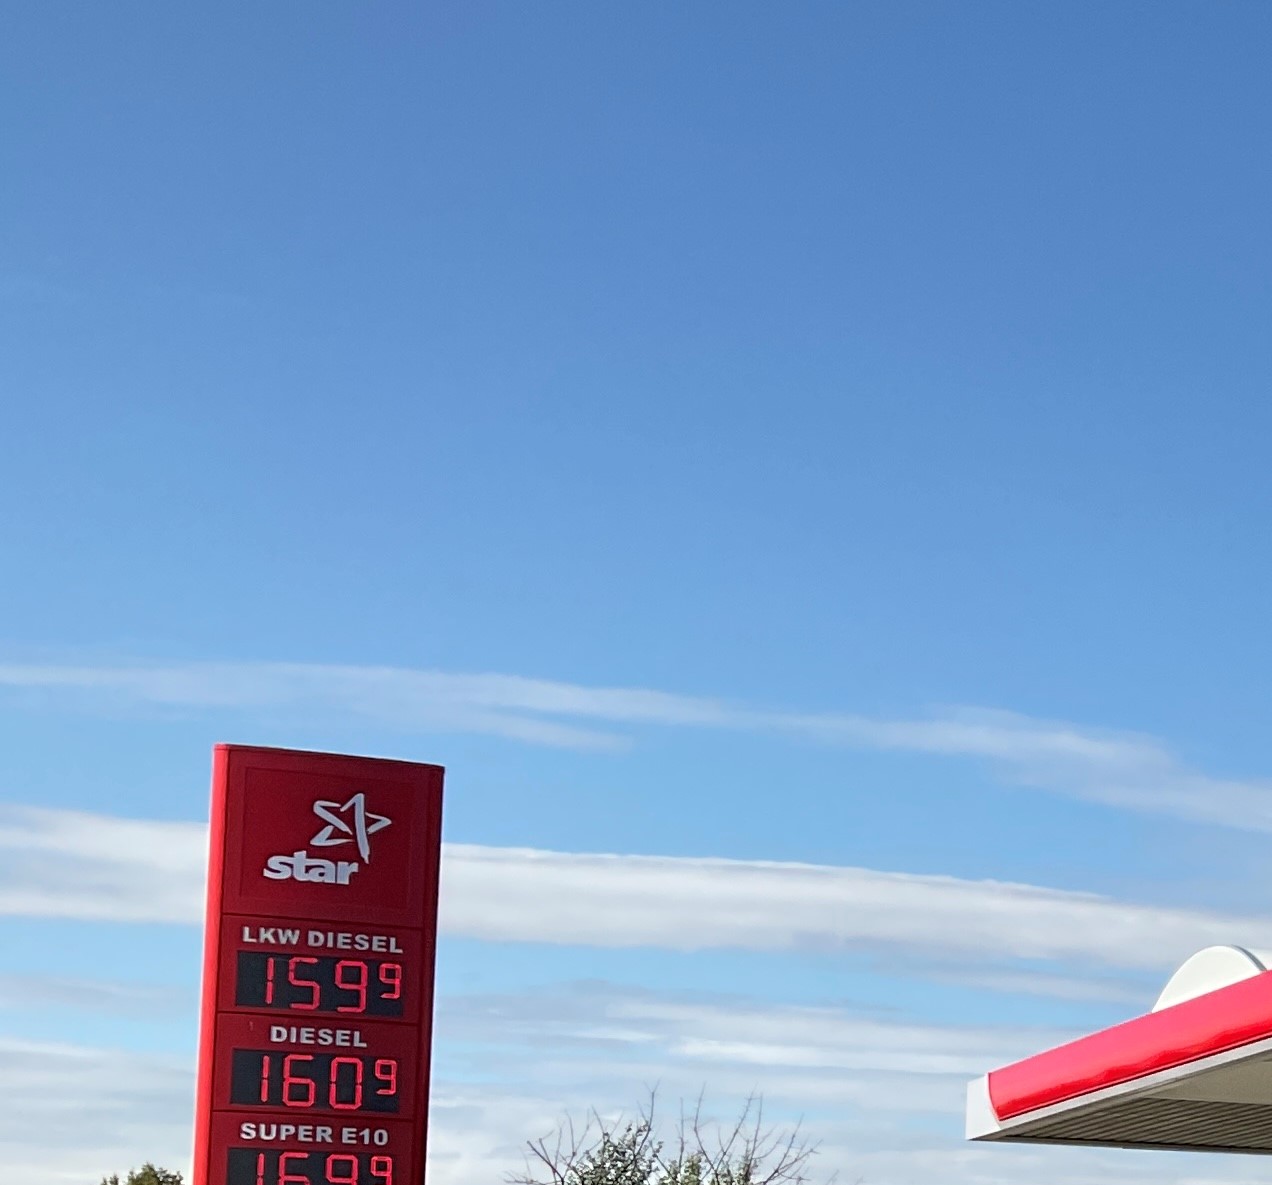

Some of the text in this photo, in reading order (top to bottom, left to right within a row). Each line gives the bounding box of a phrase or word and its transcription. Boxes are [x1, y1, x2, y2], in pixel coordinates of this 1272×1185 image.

[263, 850, 361, 885] star
[241, 925, 404, 954] LKW DIESEL
[269, 1026, 367, 1048] DIESEL
[240, 1123, 389, 1146] SUPER E10
